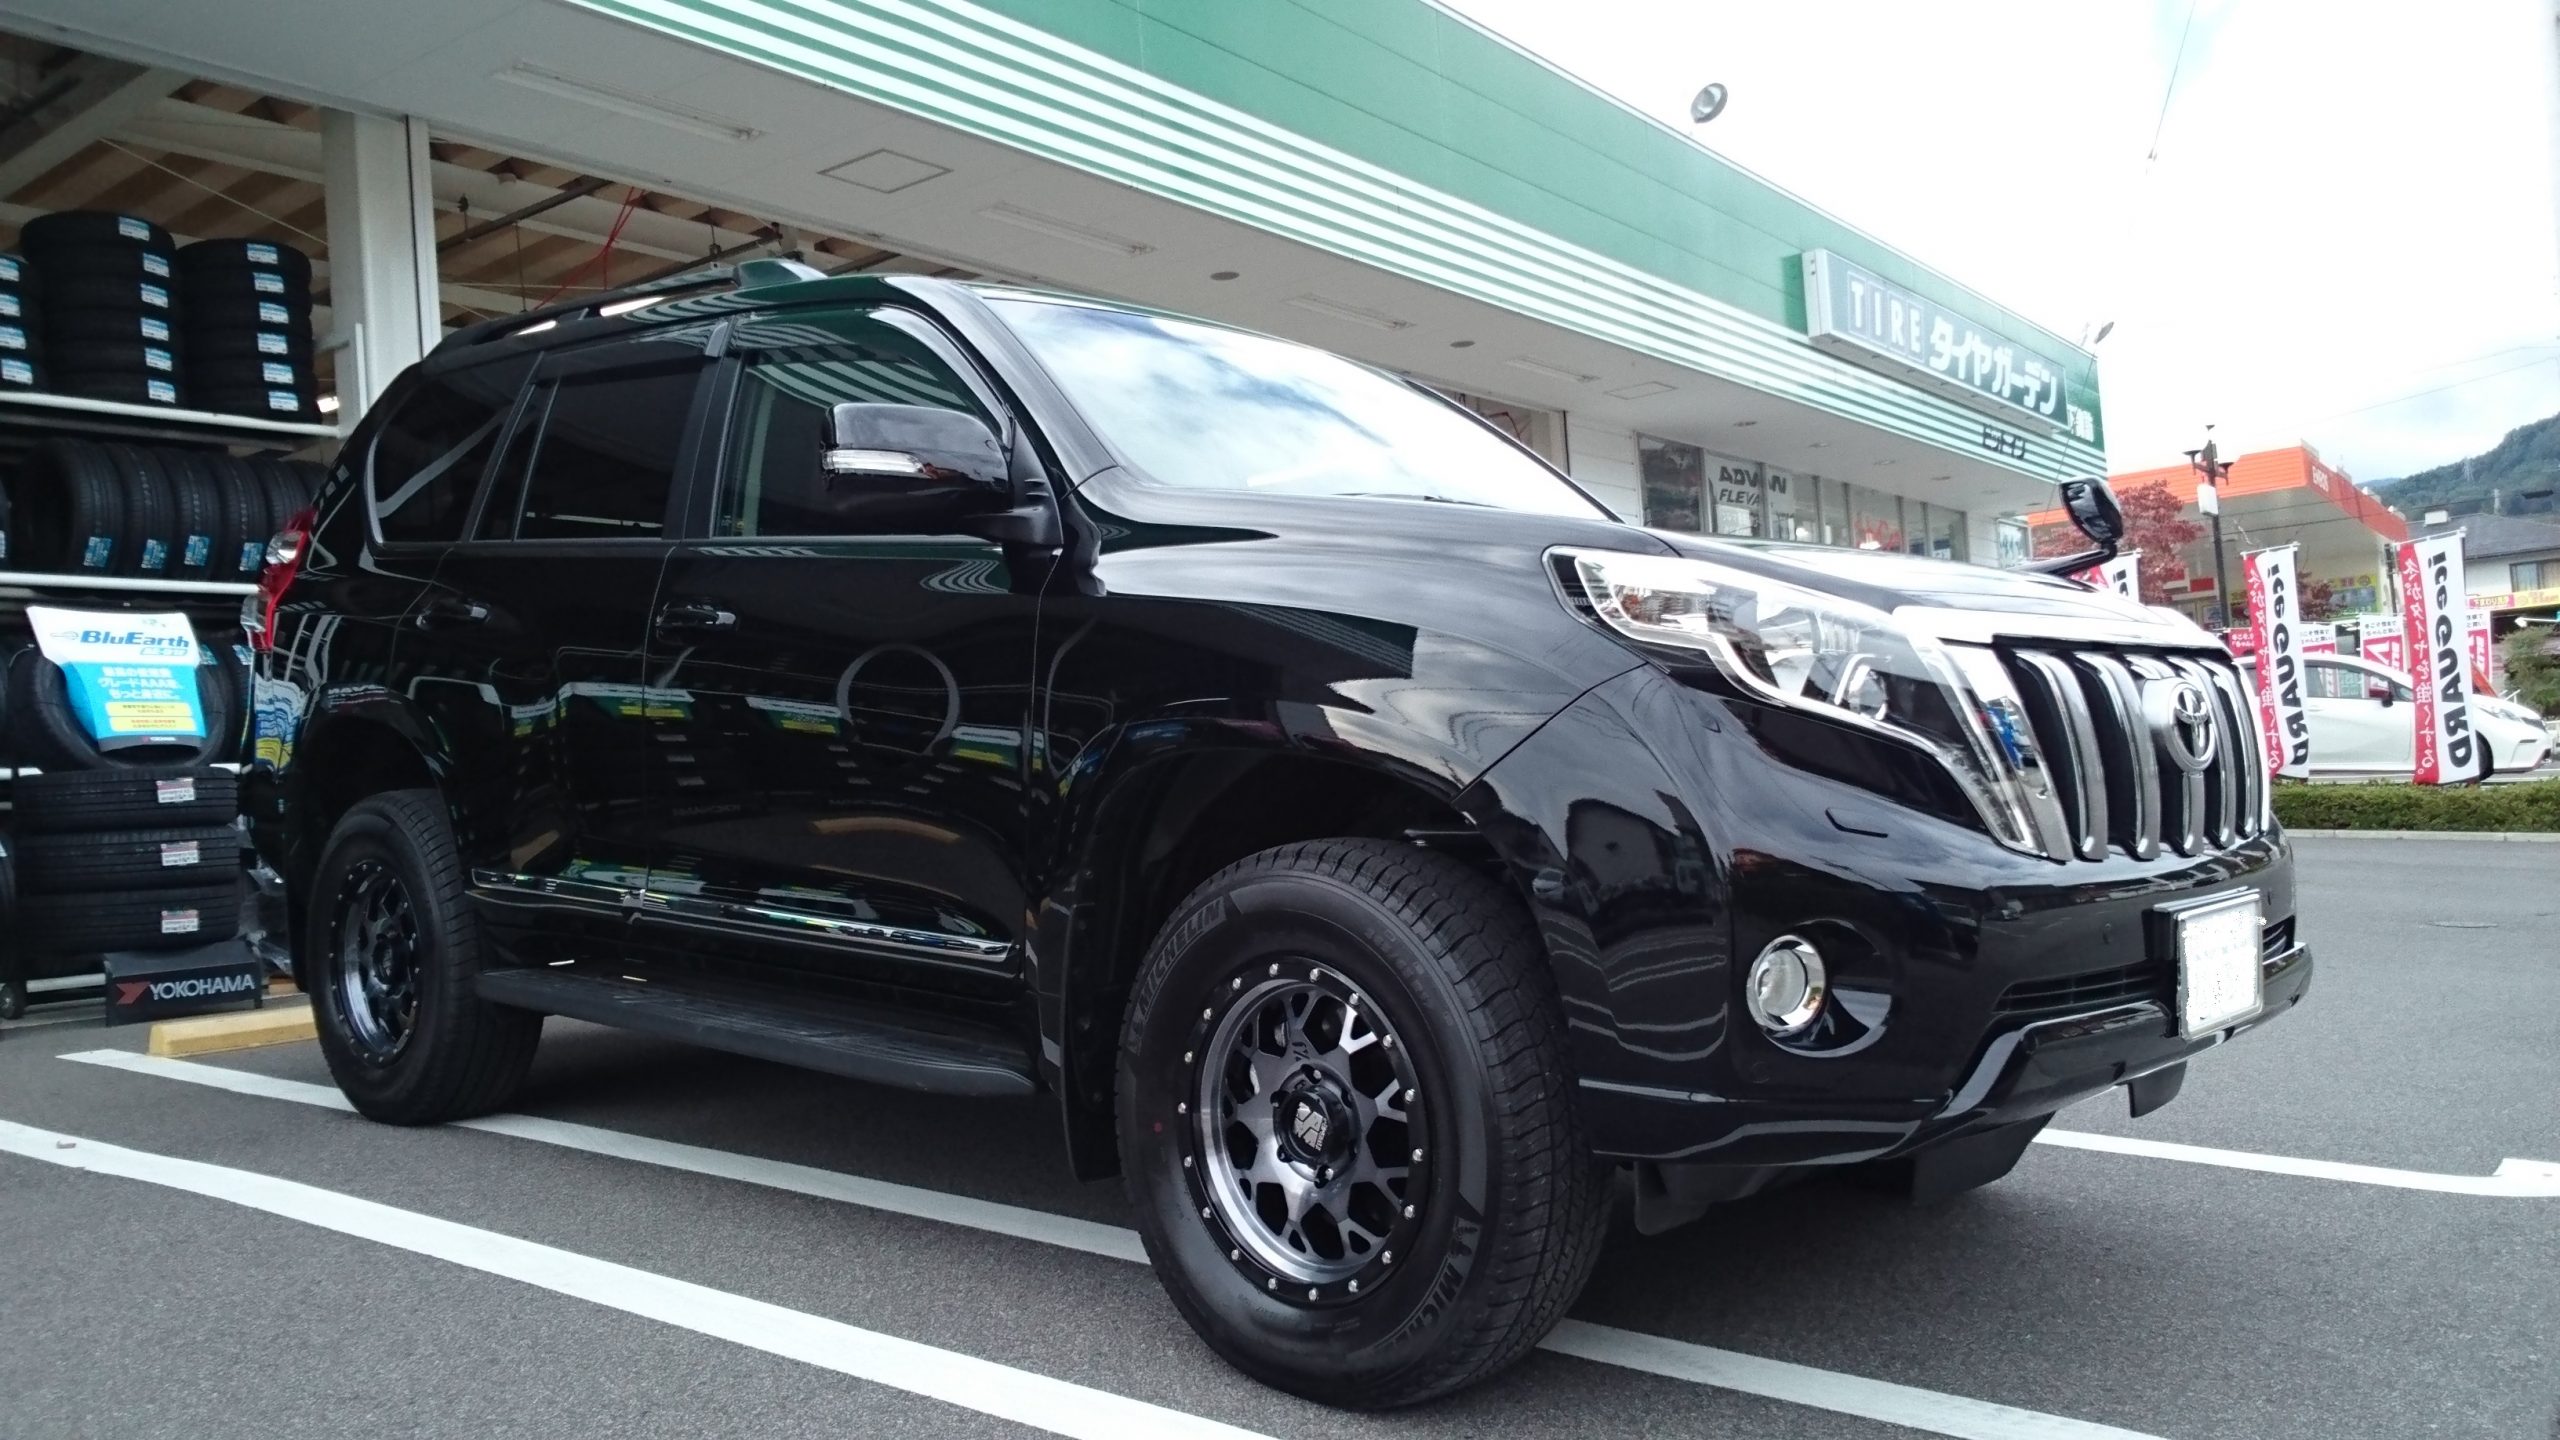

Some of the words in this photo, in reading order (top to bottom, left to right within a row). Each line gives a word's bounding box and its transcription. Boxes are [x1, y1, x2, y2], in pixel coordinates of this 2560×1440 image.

[1851, 280, 1921, 353] TIRE
[1929, 315, 2057, 415] タイヤガーデン
[1718, 466, 1787, 495] ADVN
[80, 630, 190, 648] BluEarth
[151, 974, 255, 1000] YOKOHAMA
